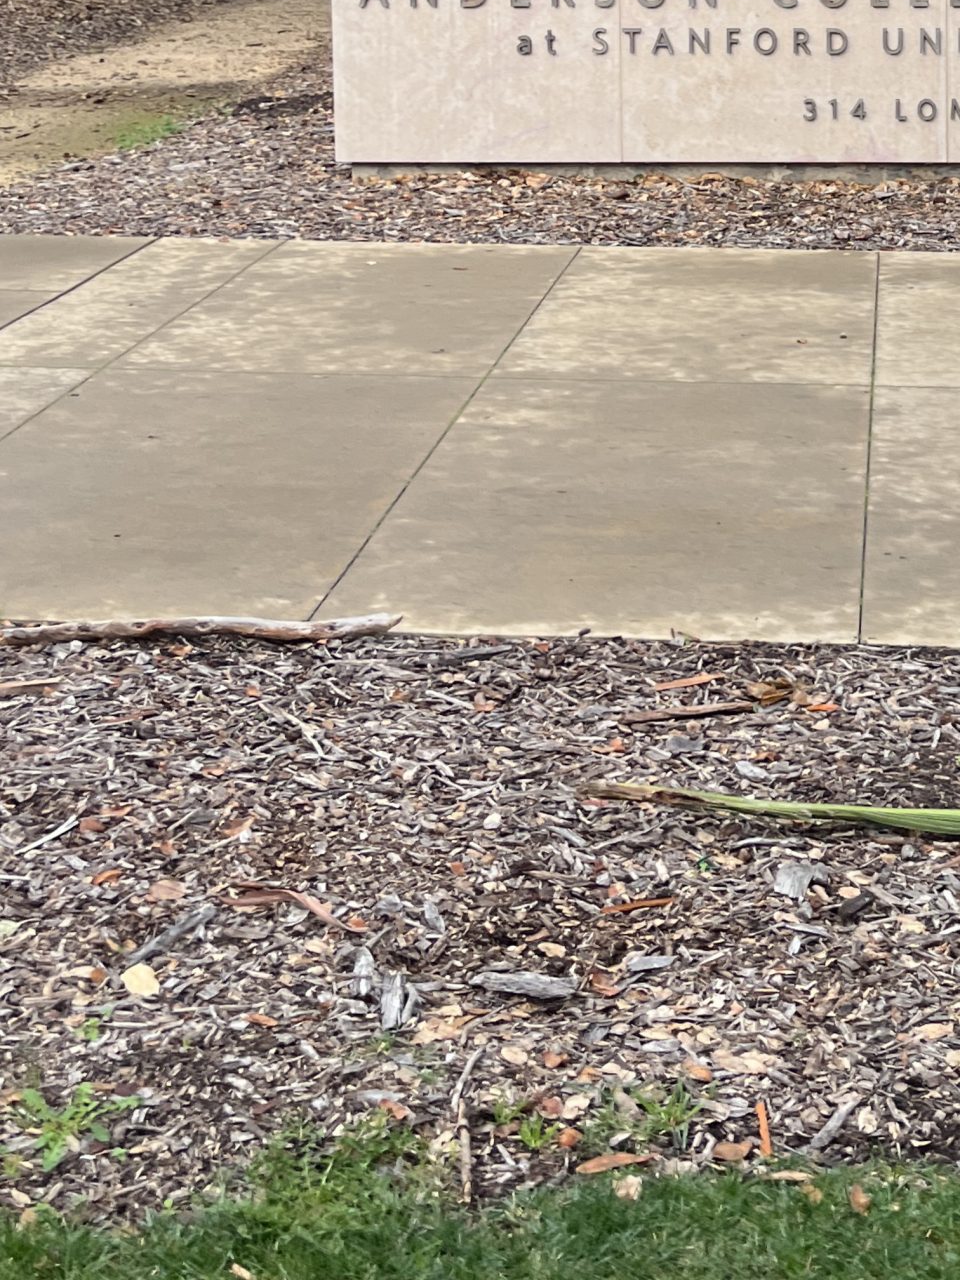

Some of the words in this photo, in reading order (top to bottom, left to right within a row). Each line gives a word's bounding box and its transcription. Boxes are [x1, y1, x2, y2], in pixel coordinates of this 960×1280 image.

[516, 29, 558, 56] at
[592, 27, 849, 56] STANFORD
[803, 98, 867, 121] 314
